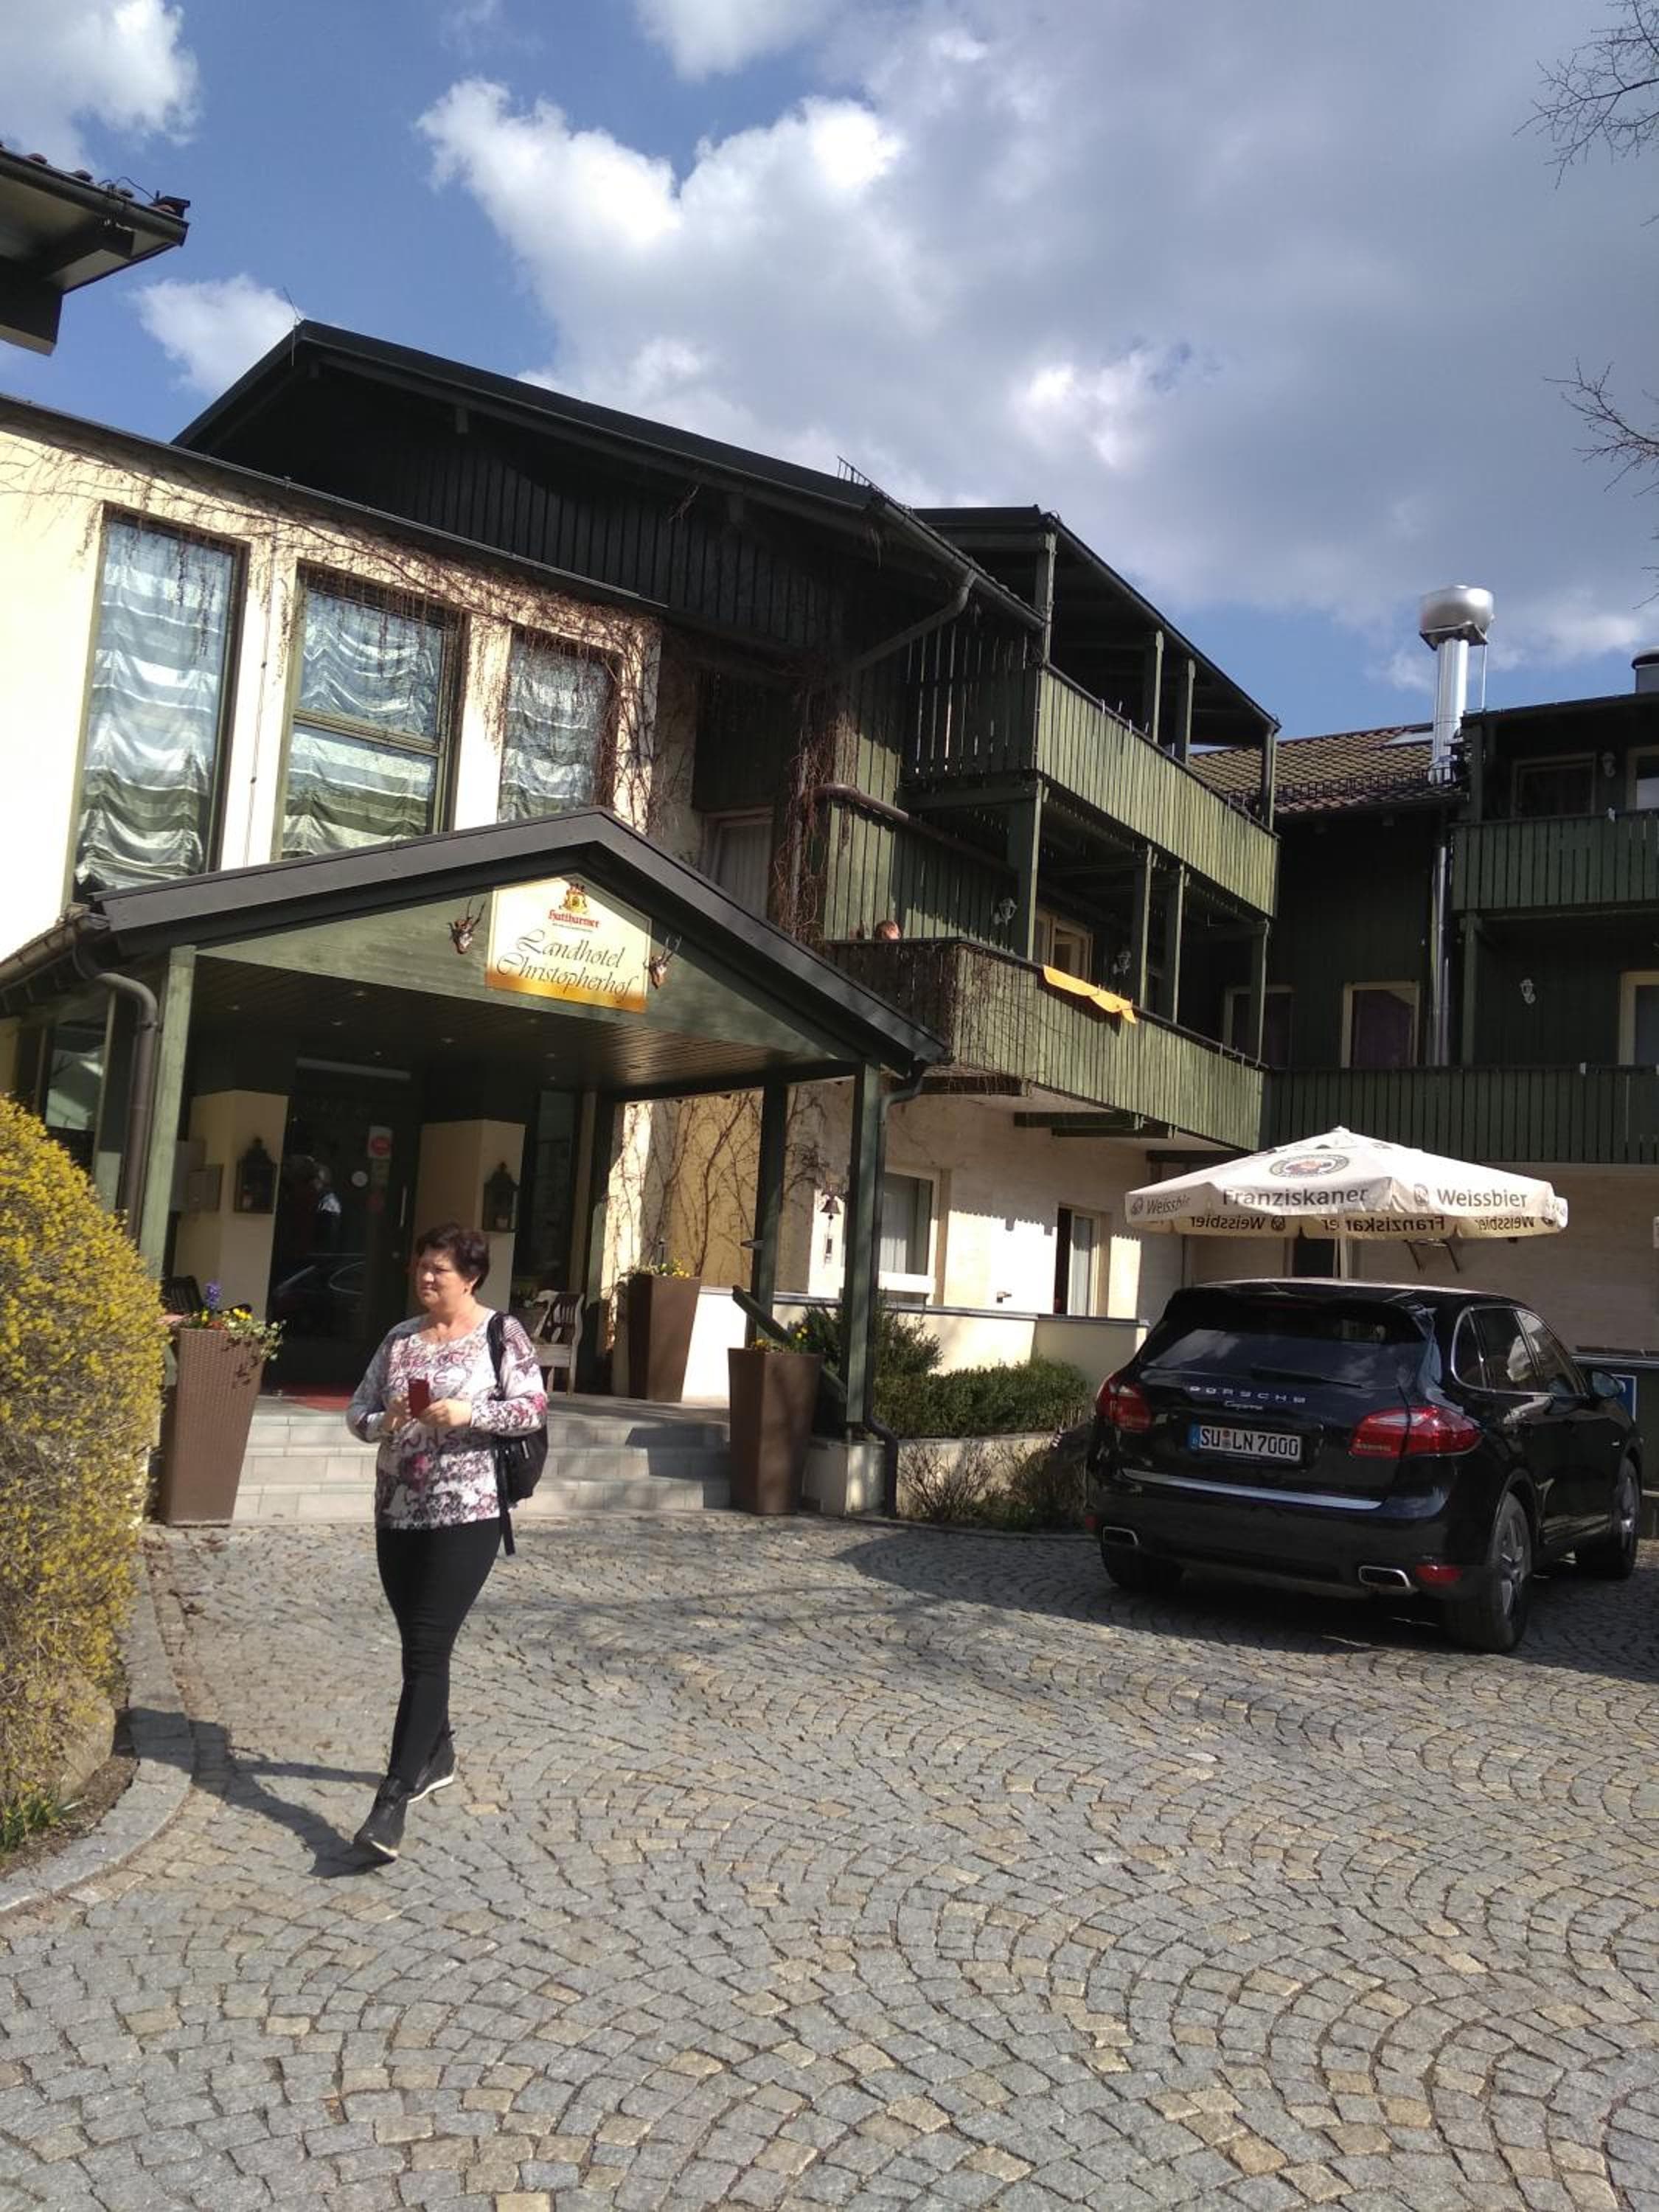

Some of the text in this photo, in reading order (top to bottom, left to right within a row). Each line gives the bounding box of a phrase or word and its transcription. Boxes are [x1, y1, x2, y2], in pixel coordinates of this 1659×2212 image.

[517, 928, 626, 968] Landhotel
[496, 952, 639, 1004] Christopherhof
[1147, 1194, 1191, 1214] Weissbi
[1222, 1188, 1369, 1207] Franziskaner
[1437, 1189, 1528, 1208] Weissbier
[1189, 1385, 1306, 1403] PORSCHE
[1201, 1428, 1221, 1447] SU
[1232, 1431, 1253, 1452] LN
[1256, 1436, 1299, 1456] 7000
